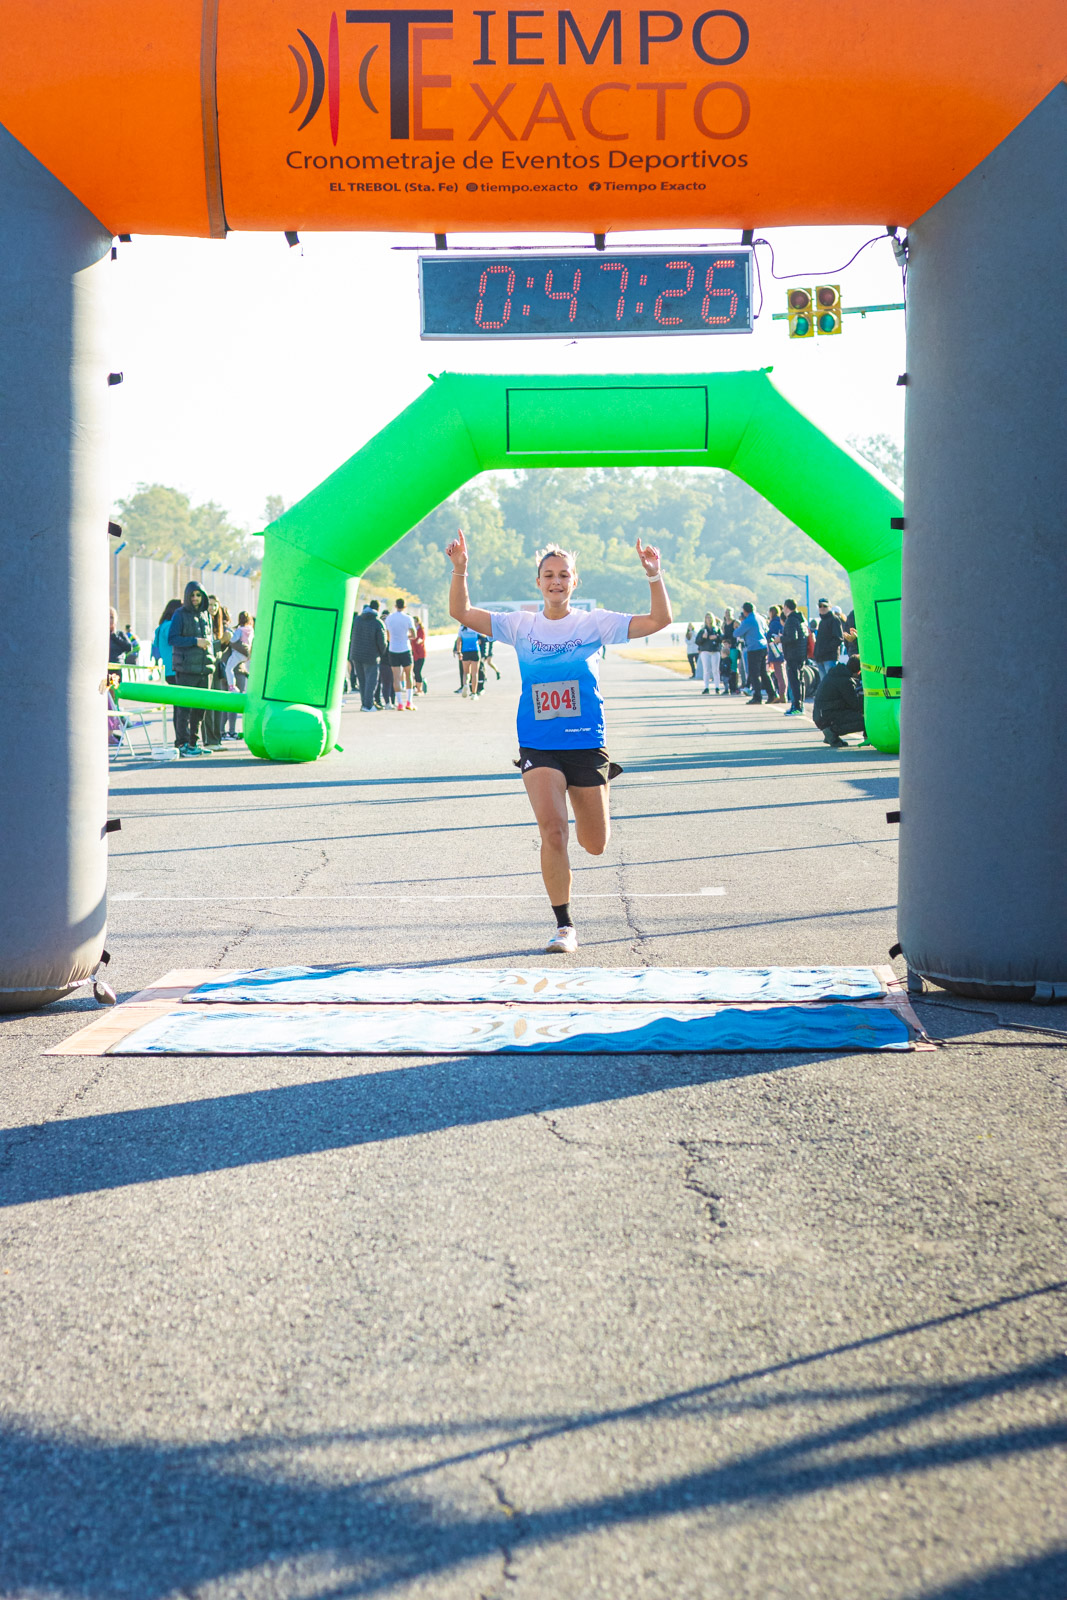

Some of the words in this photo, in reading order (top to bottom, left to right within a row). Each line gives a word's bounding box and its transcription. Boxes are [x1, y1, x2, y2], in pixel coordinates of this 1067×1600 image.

[286, 150, 456, 174] Cronometraje
[462, 150, 494, 169] de
[502, 151, 601, 169] Eventos
[608, 150, 749, 172] Deportivos
[329, 182, 345, 192] EL
[348, 182, 401, 192] TREBOL
[405, 182, 435, 193] (Sta.
[438, 182, 458, 193] Fe)
[481, 182, 578, 194] tiempo.exacto
[603, 181, 657, 192] Tiempo
[660, 181, 707, 191] Exacto
[540, 689, 572, 712] 204
